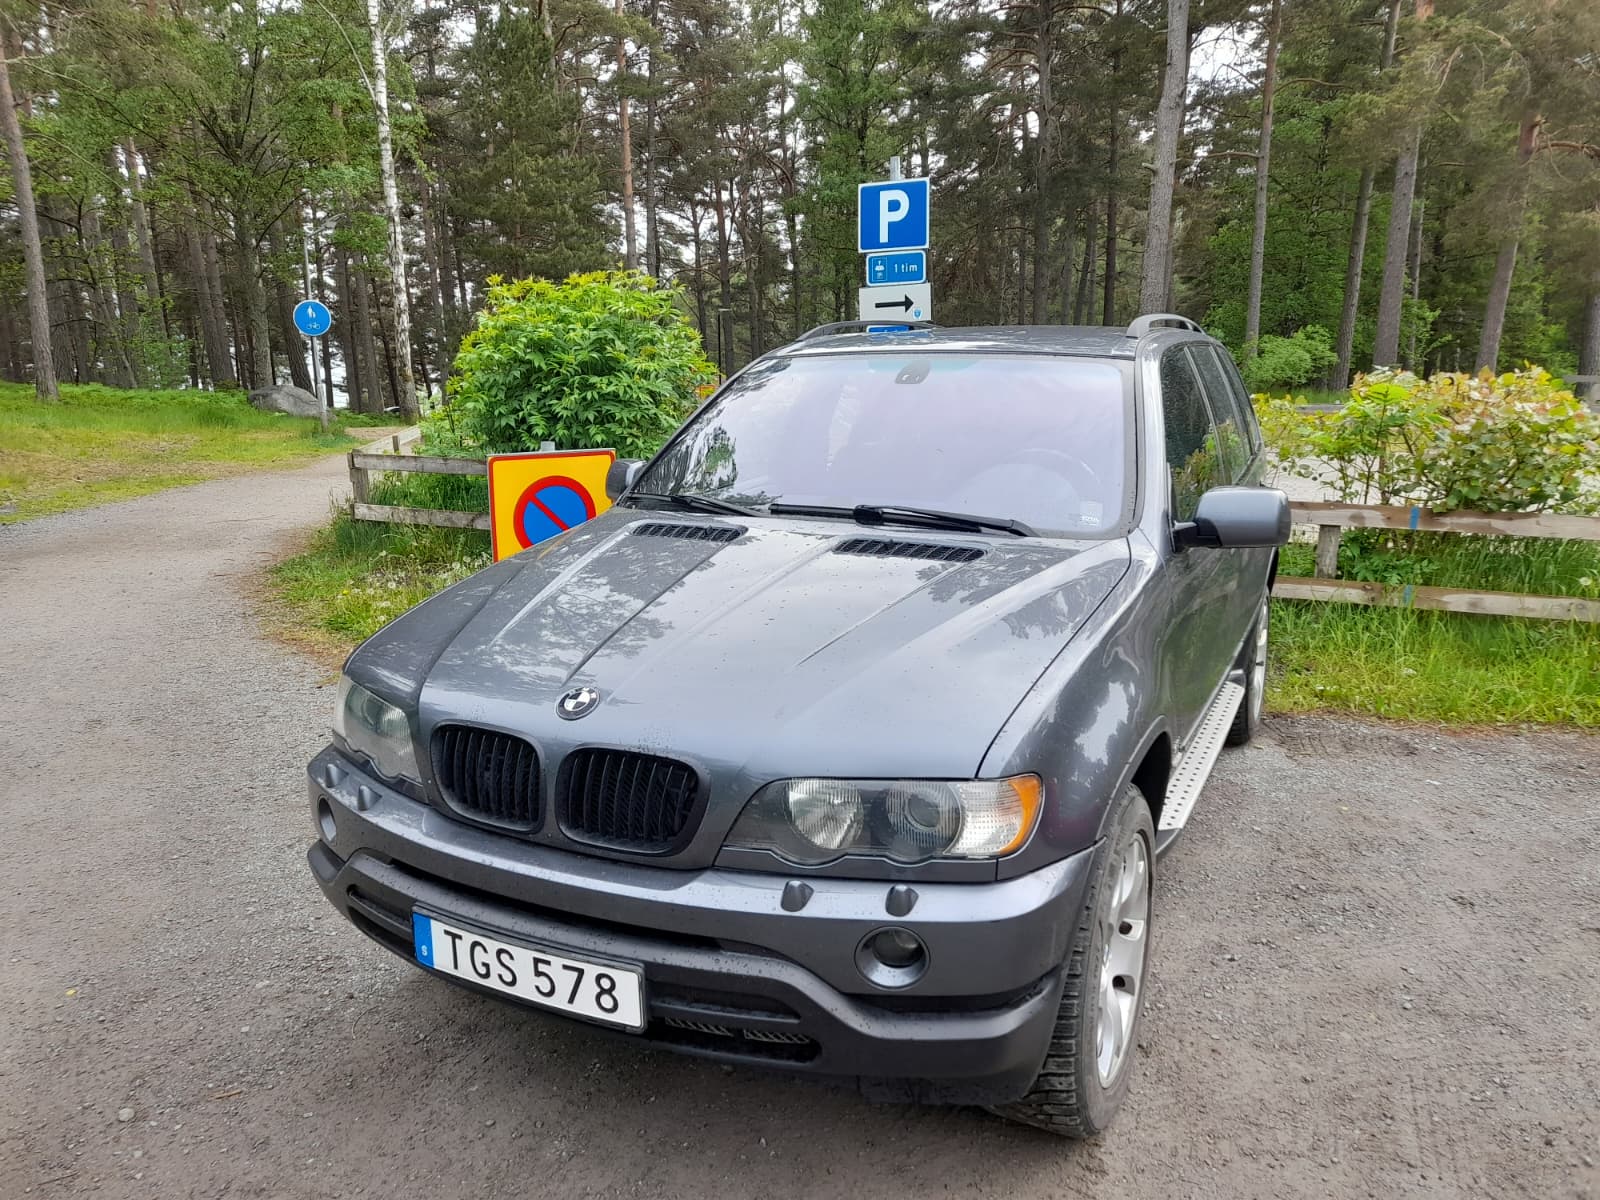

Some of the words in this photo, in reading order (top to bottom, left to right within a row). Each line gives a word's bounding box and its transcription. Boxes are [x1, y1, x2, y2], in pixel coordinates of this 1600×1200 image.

[879, 189, 910, 243] P
[894, 263, 898, 273] 1
[901, 262, 918, 273] tim
[443, 929, 518, 988] TGS
[532, 956, 620, 1014] 578
